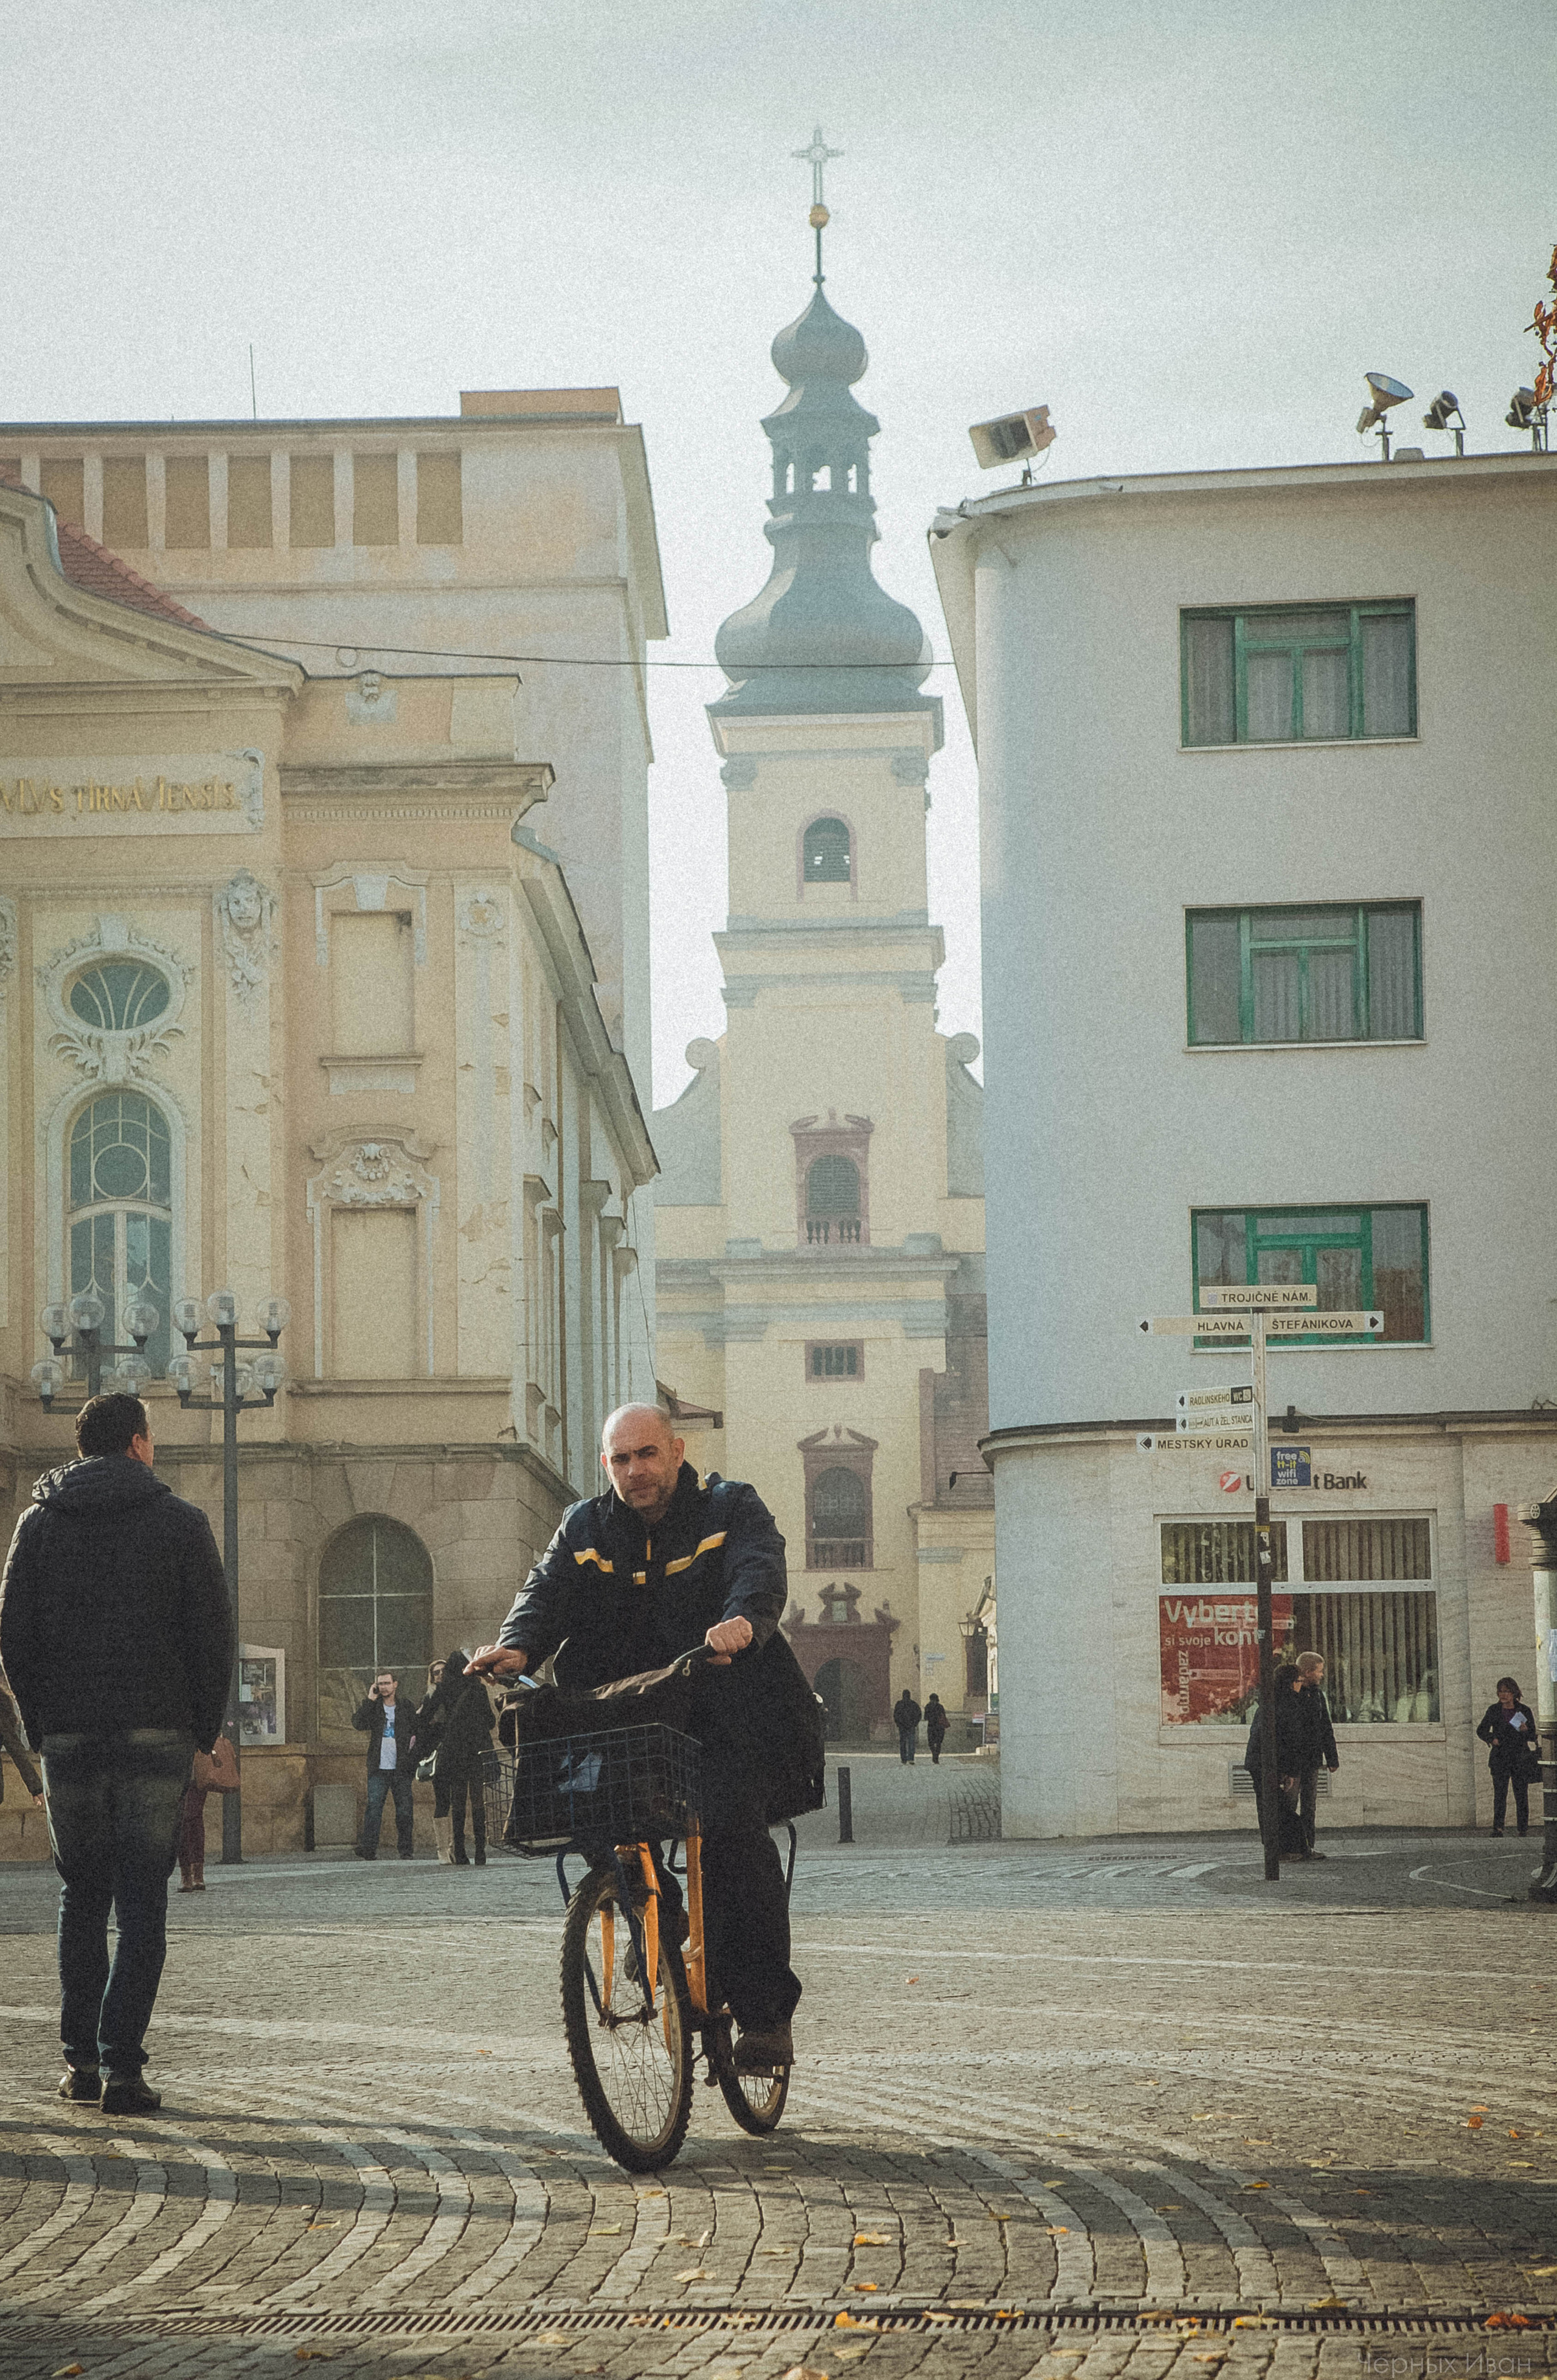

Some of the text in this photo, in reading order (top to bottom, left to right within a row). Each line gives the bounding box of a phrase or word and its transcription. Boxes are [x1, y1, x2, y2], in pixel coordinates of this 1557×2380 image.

[1221, 1290, 1312, 1303] TROJIČNÉ NÁM.
[1198, 1319, 1244, 1331] HLAVNÁ
[1272, 1317, 1353, 1330] ŠTEFÁNIKOVA
[1233, 1392, 1243, 1402] WC
[1231, 1415, 1252, 1424] STANICA
[1157, 1437, 1249, 1449] MESTSKÝ ÚRAD
[1277, 1451, 1297, 1460] free
[1277, 1460, 1296, 1468] tt-it
[1278, 1468, 1296, 1478] wifi
[1323, 1471, 1367, 1490] Bank
[1164, 1599, 1258, 1627] Vybert
[1165, 1626, 1274, 1648] si svoje kont
